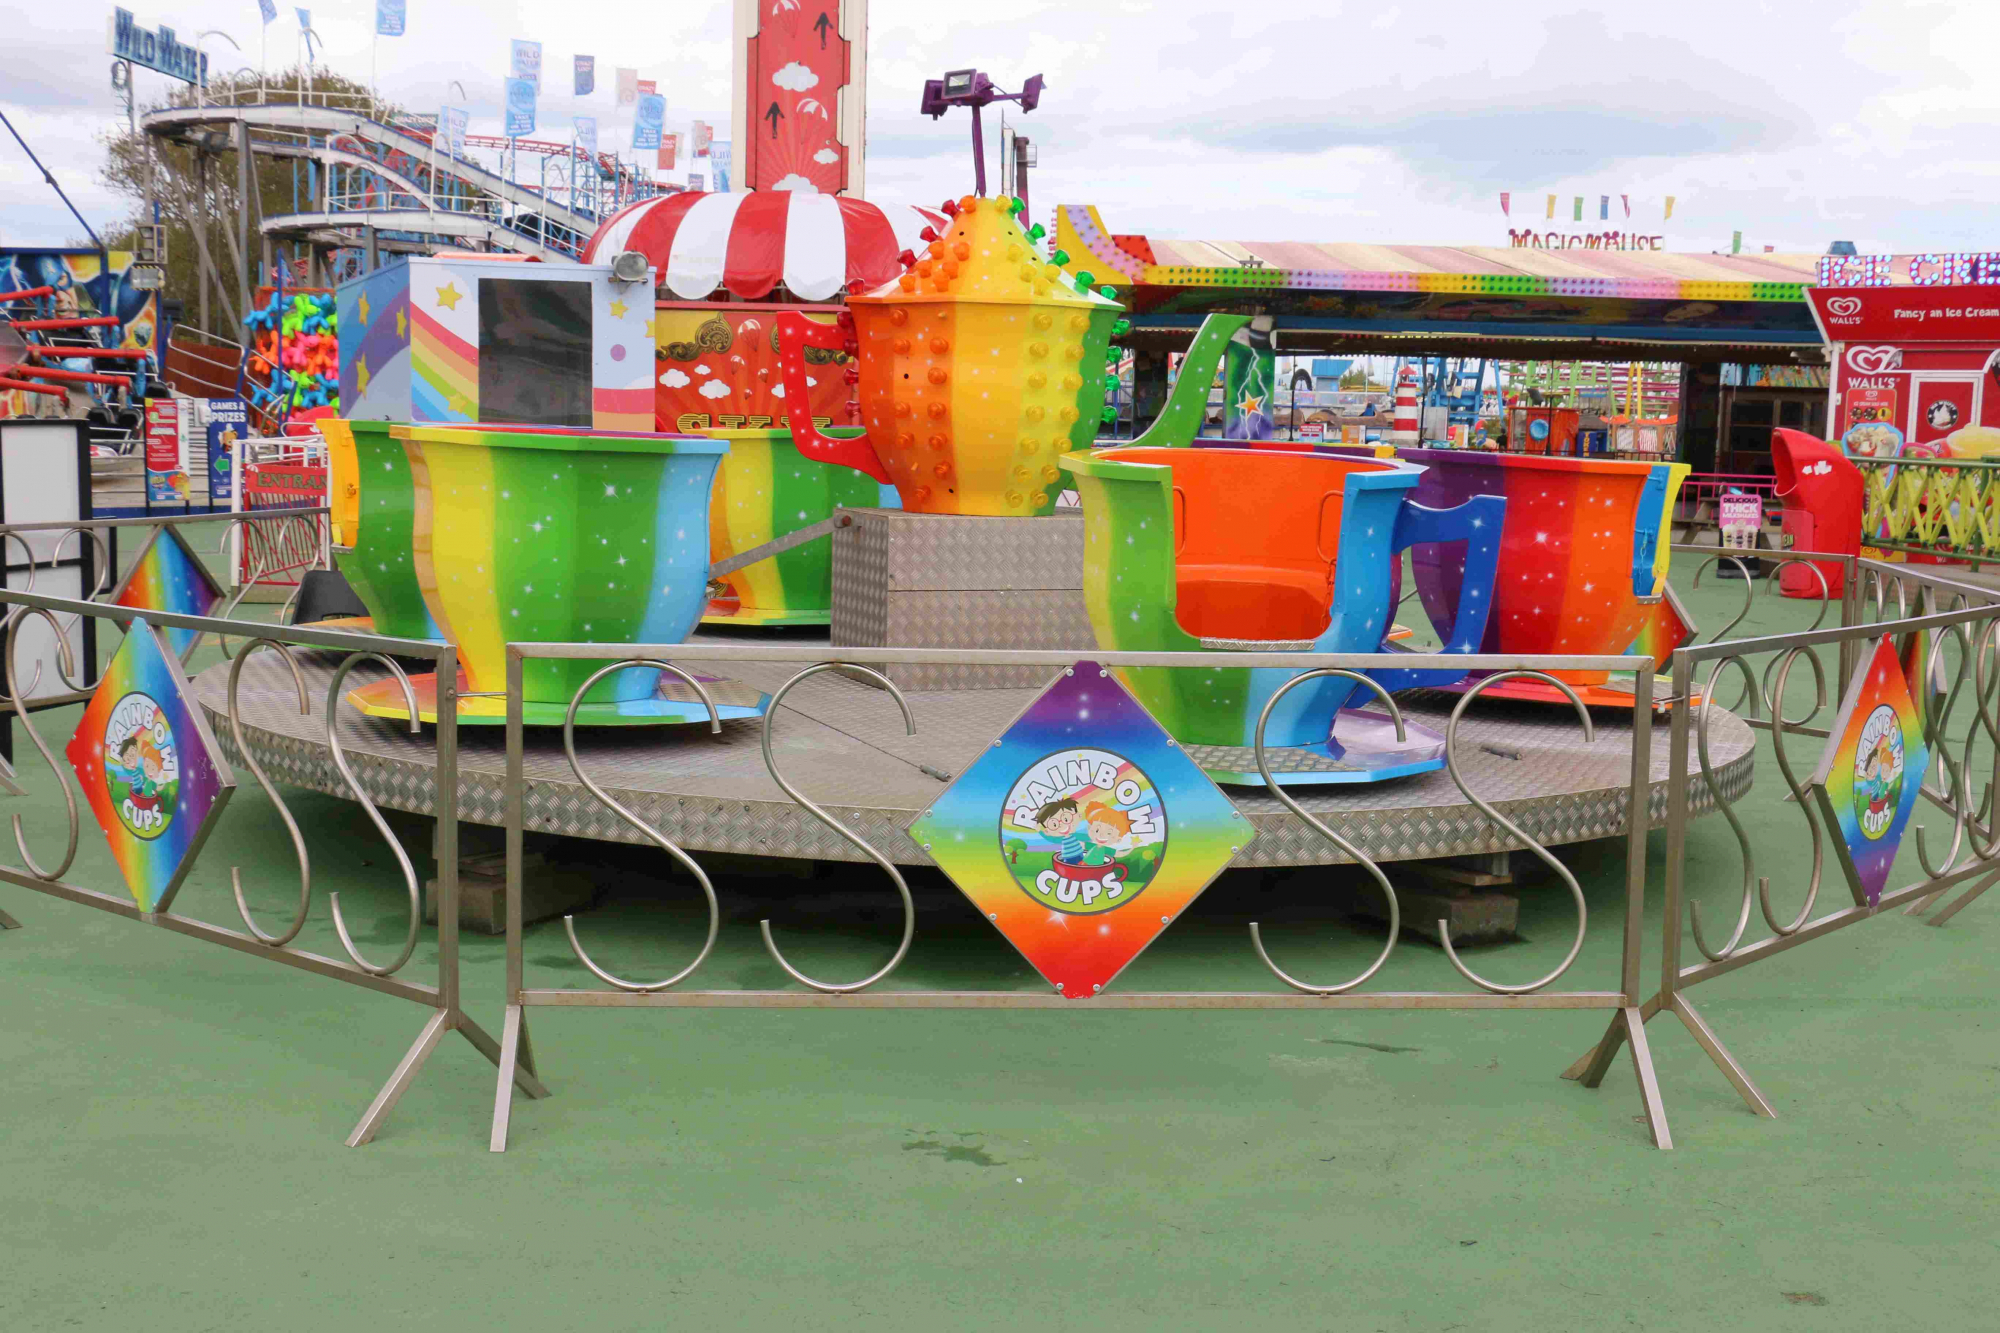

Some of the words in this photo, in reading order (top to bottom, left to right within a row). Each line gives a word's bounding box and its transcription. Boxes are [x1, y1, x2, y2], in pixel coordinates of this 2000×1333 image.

[1820, 254, 1892, 287] ICE
[1829, 316, 1862, 325] WALL'S
[1894, 308, 1926, 322] Fancy
[1929, 309, 1943, 318] an
[1945, 307, 1962, 317] Ice
[1965, 307, 2000, 318] Cream
[1848, 377, 1896, 388] WALL'S
[210, 402, 238, 411] GAMES
[239, 402, 245, 410] &
[211, 412, 246, 423] PRIZES
[1722, 503, 1759, 513] THICK
[109, 702, 175, 772] RAINBOW
[1858, 714, 1902, 778] RAINBOW
[1012, 759, 1156, 834] RAINBOW
[122, 798, 163, 831] CUPS
[1863, 802, 1891, 833] CUPS
[1035, 869, 1124, 905] CUPS
